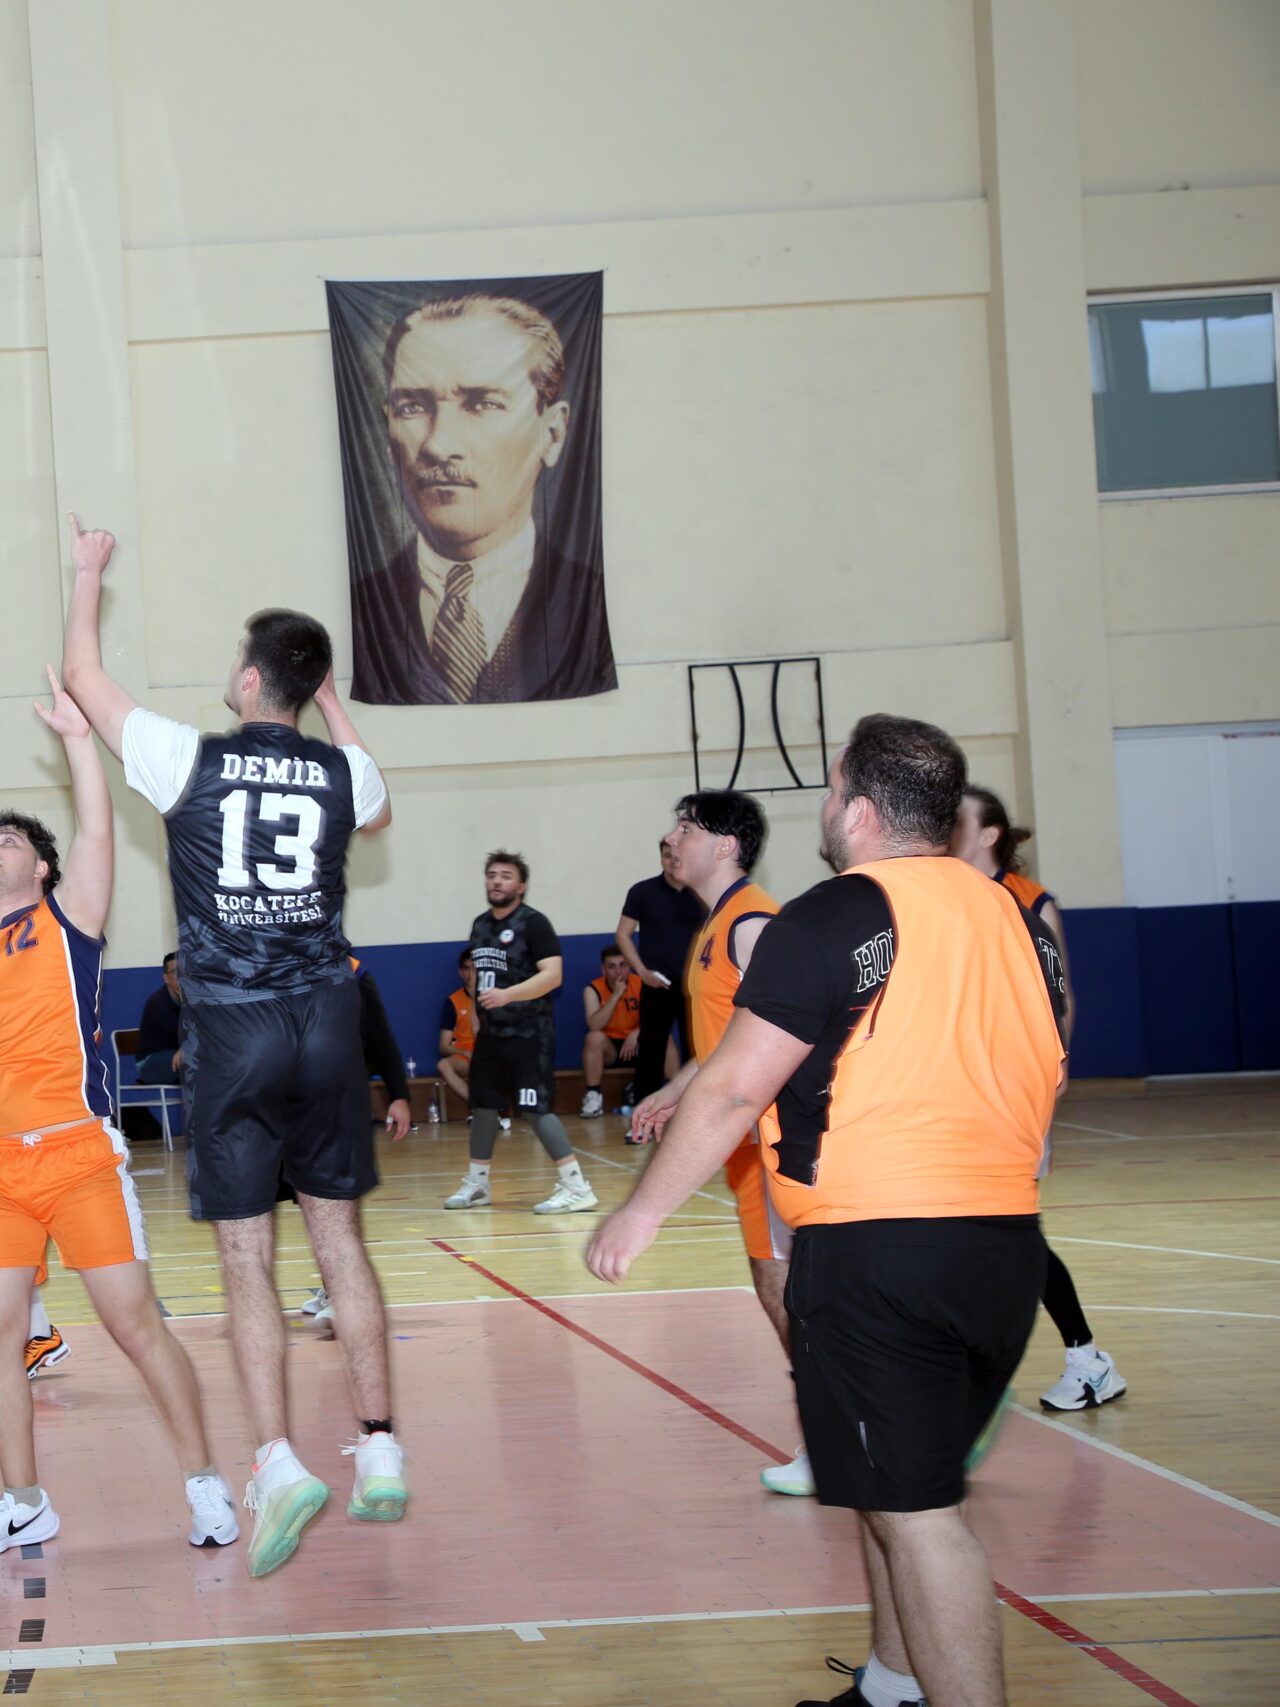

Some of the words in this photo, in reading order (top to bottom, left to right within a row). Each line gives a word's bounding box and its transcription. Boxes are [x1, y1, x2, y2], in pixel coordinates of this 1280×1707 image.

[220, 753, 327, 787] DEMİR
[216, 789, 321, 890] 13
[4, 912, 39, 956] 12
[697, 931, 715, 971] 4
[477, 971, 496, 992] 10
[519, 1088, 537, 1106] 10
